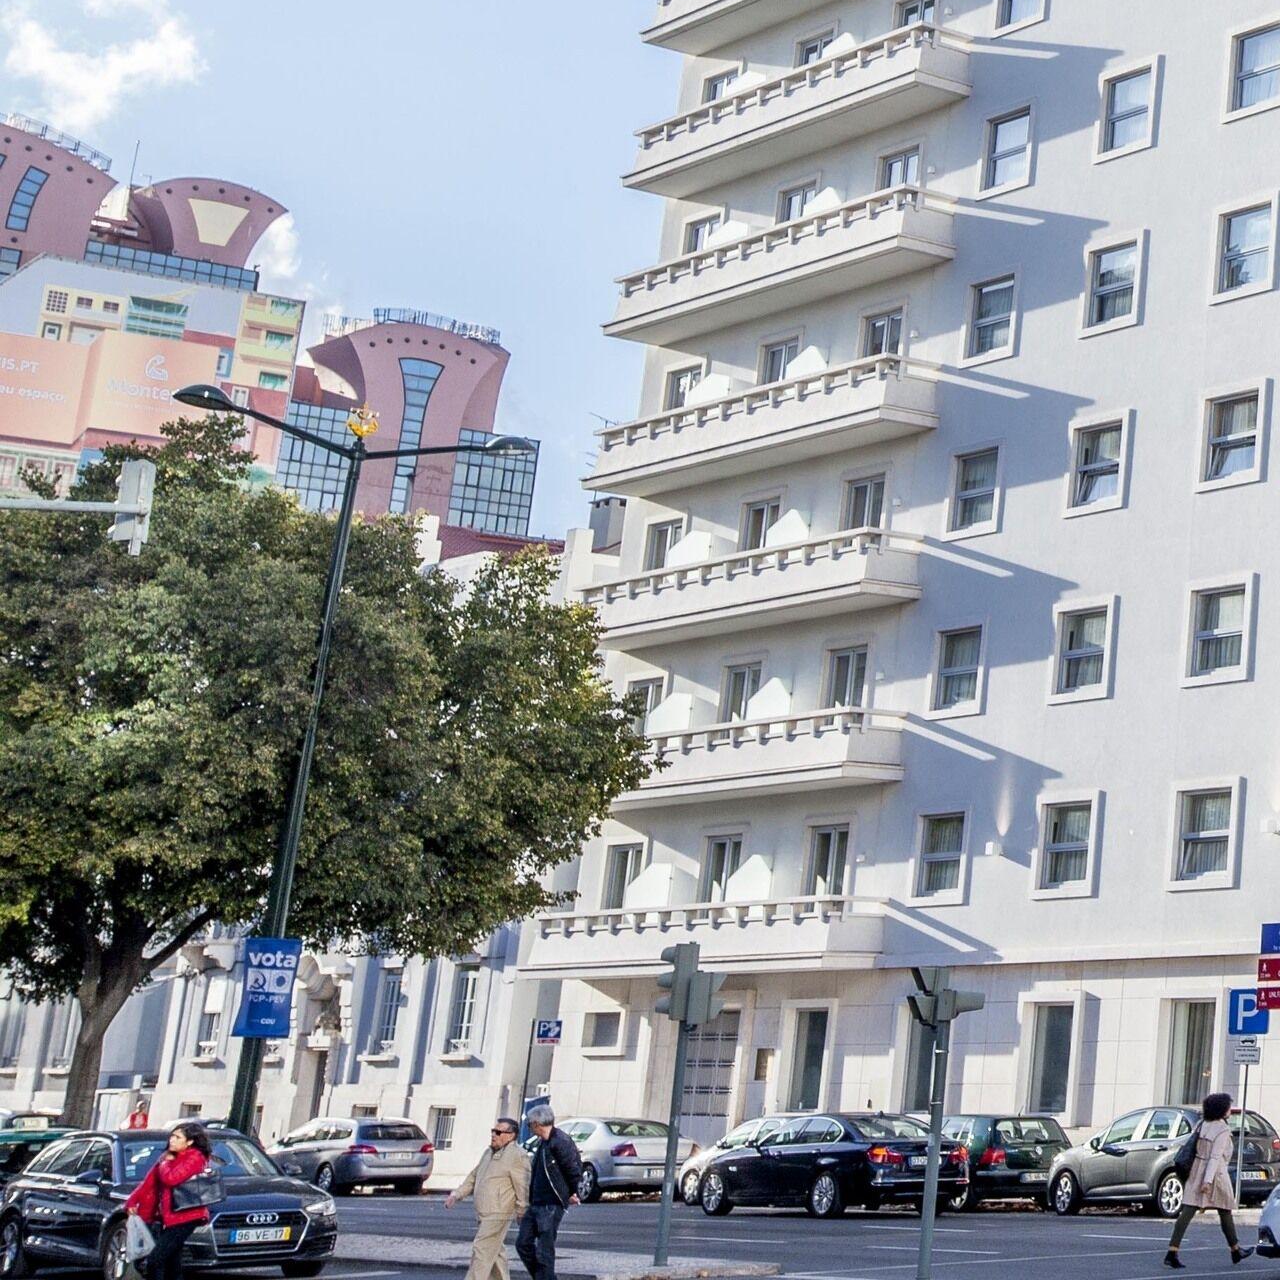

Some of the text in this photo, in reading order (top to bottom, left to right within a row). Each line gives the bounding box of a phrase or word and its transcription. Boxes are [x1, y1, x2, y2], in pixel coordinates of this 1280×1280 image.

[0, 357, 40, 373] IS.PT
[249, 951, 297, 968] vota
[1237, 994, 1261, 1031] P
